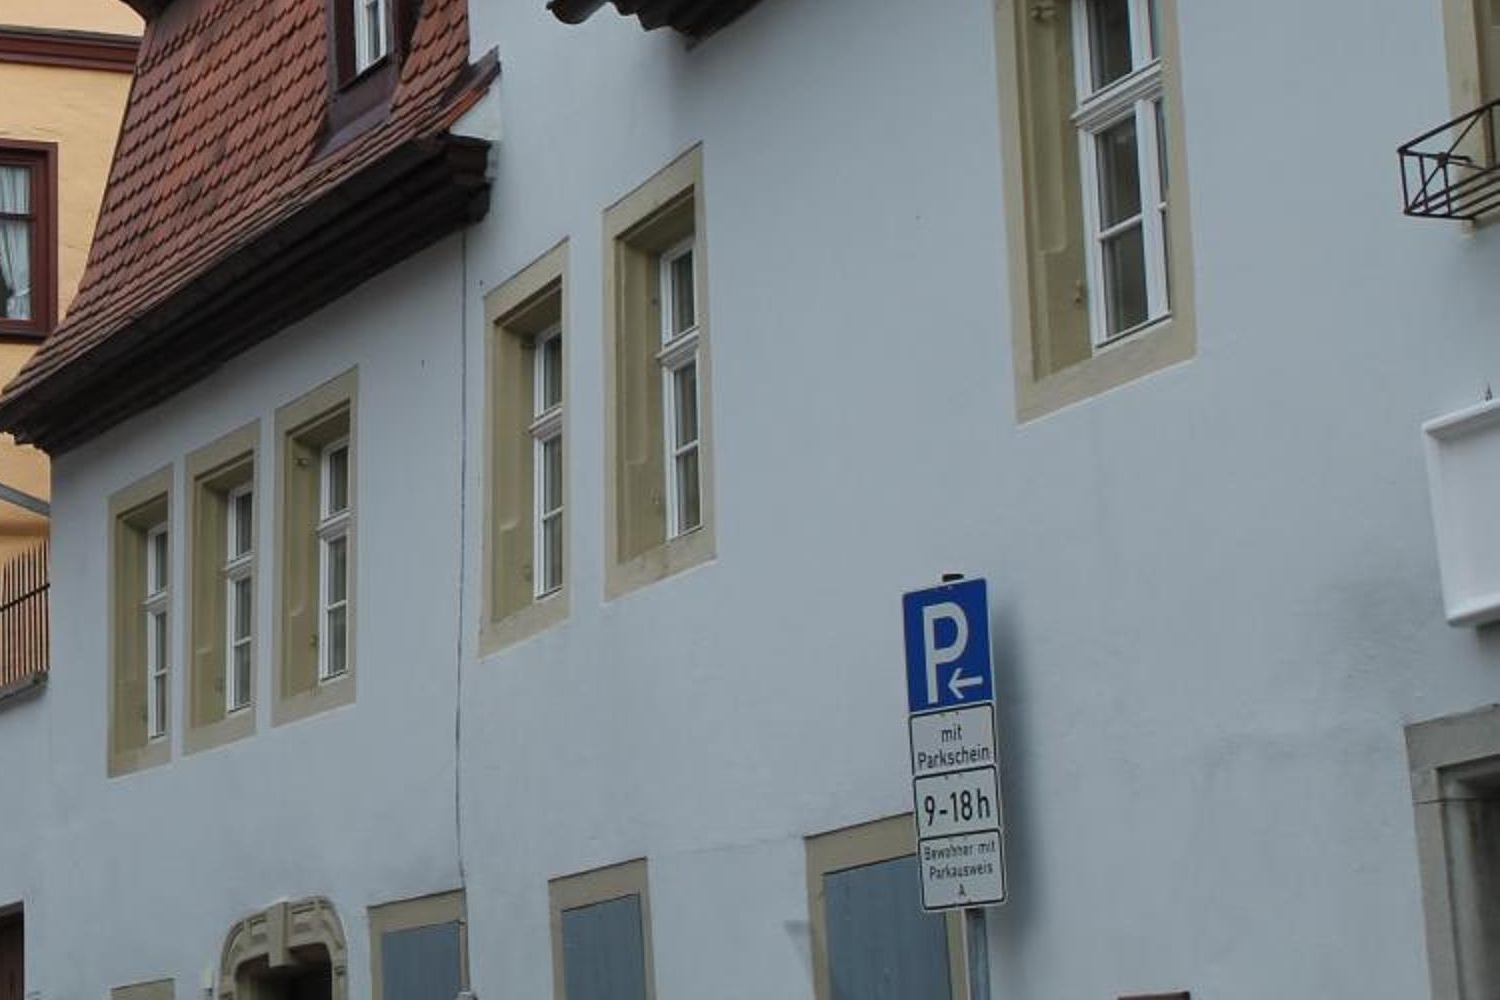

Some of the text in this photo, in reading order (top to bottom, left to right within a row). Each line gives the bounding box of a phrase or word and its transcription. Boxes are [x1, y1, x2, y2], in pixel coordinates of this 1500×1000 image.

[922, 601, 969, 704] P
[940, 723, 963, 743] mit
[917, 744, 990, 770] Parkschein
[923, 840, 996, 861] Bewohner mit
[929, 863, 994, 881] Parkausweis
